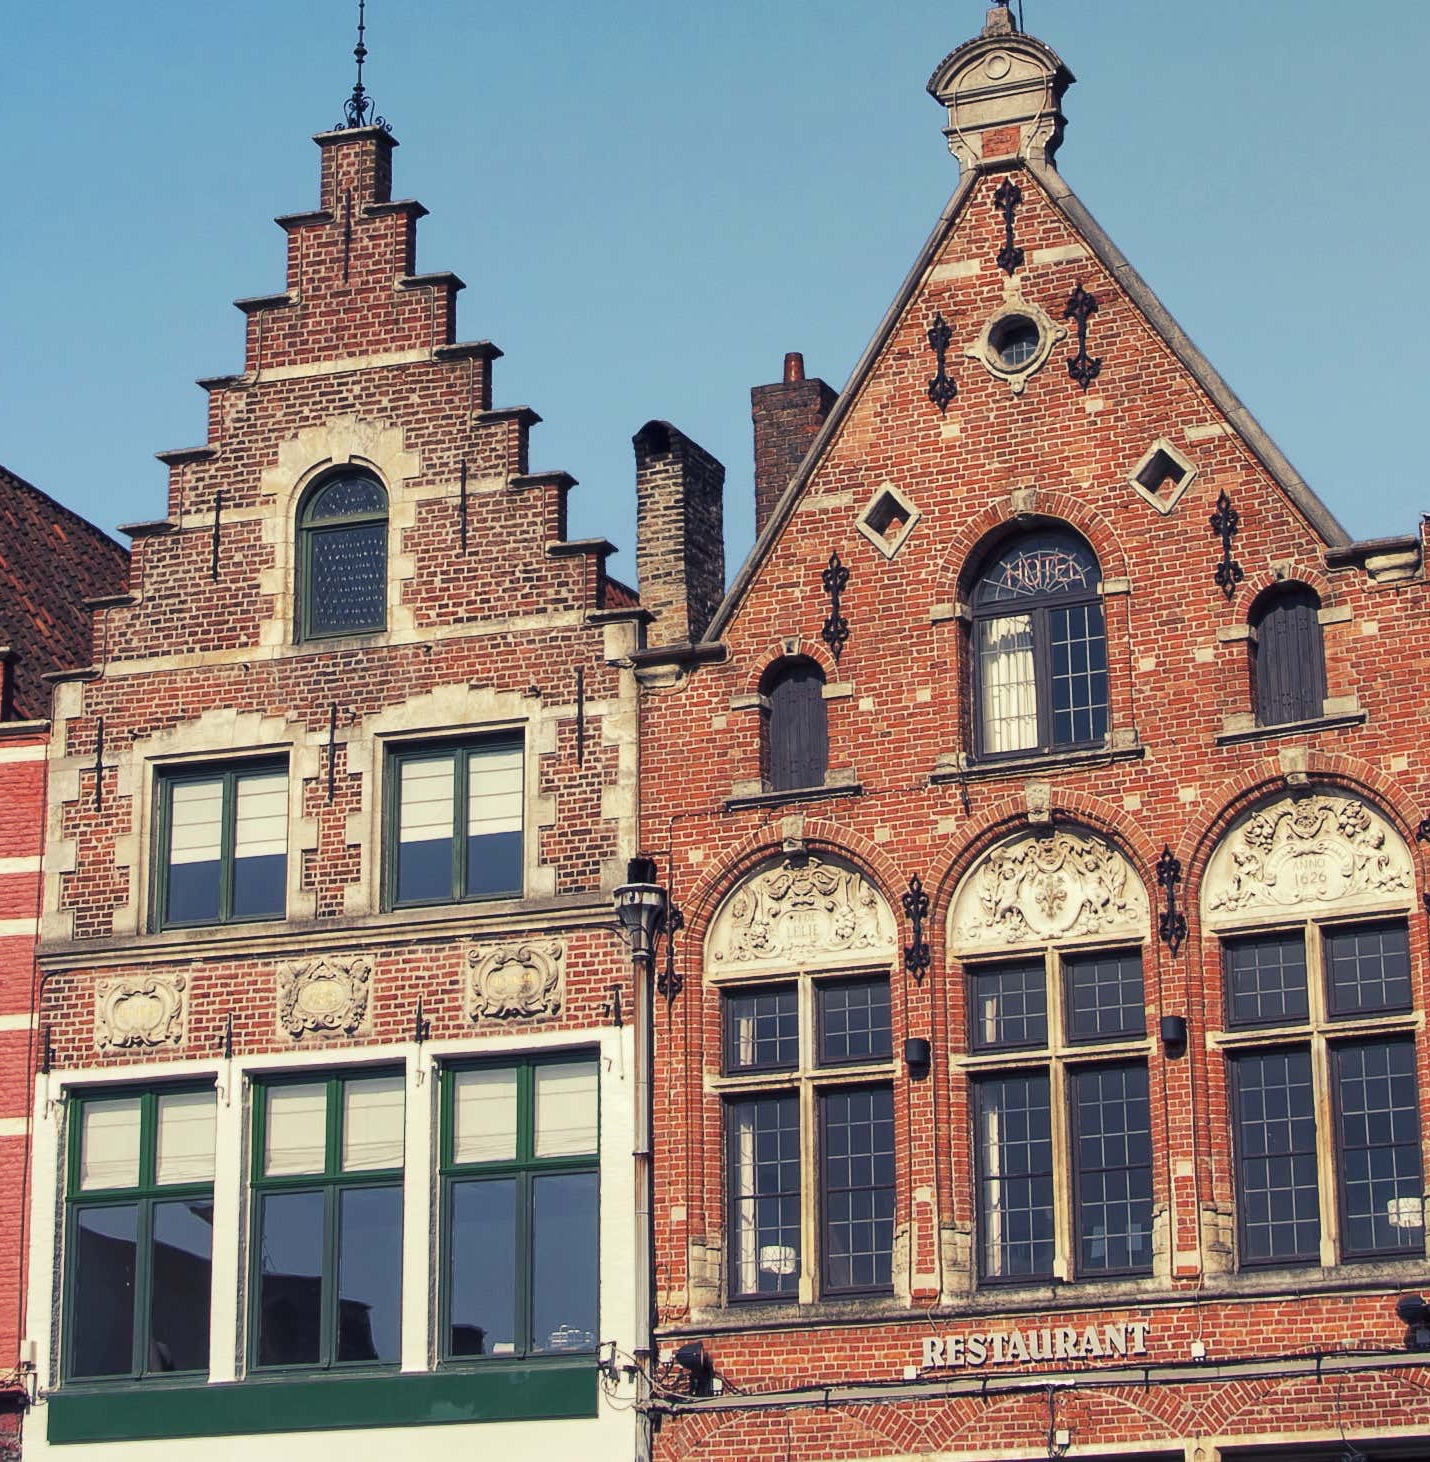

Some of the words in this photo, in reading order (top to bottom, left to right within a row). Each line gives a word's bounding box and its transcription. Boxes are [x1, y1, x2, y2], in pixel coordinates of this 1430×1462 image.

[1006, 554, 1083, 588] HOTEL
[1293, 859, 1325, 870] ANNO
[1294, 871, 1327, 886] 1626
[922, 1322, 1150, 1368] RESTAURANT
